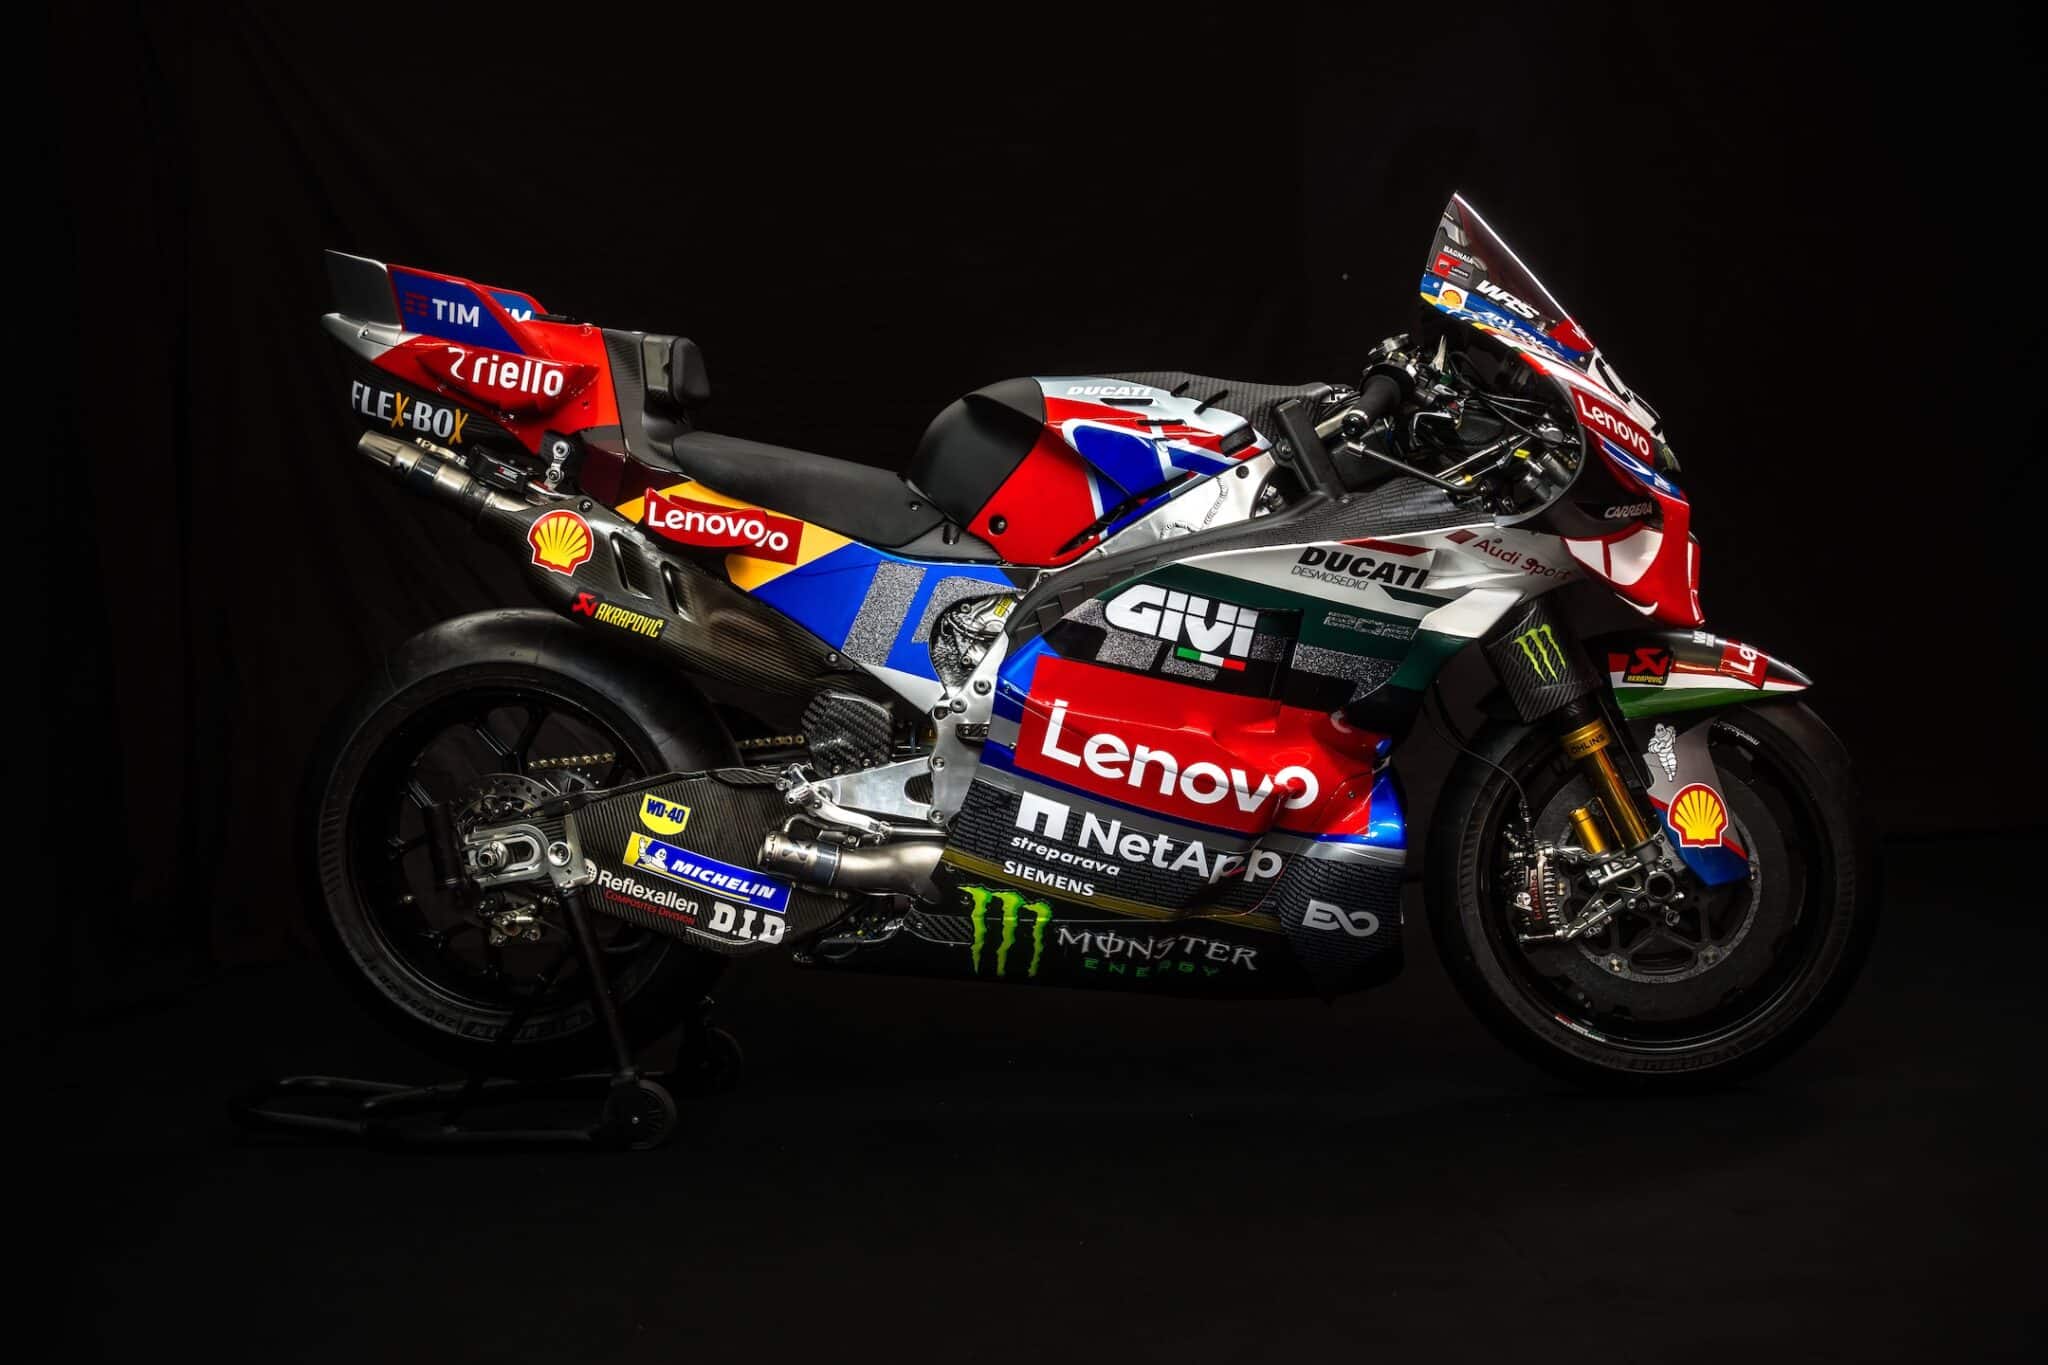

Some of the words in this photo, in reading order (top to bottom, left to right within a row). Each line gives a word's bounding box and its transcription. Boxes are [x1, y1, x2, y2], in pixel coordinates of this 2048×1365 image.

[431, 298, 480, 328] TIM
[472, 353, 564, 396] riello
[1067, 385, 1152, 397] DUCATI
[352, 380, 469, 445] FLEX-BOX
[1578, 394, 1650, 456] Lenovo
[646, 502, 768, 540] Lenovo
[1604, 503, 1653, 519] CARRERA
[1291, 564, 1370, 591] DESMOSEDICI
[1299, 546, 1430, 590] DUCATI
[1472, 538, 1521, 564] Audi
[1520, 556, 1571, 580] Sport
[1105, 584, 1259, 657] GIVI
[1041, 699, 1320, 813] Lenovo
[646, 798, 685, 824] WD-40
[1011, 835, 1121, 877] streparava
[1078, 812, 1283, 884] NetApp
[597, 870, 699, 916] Reflexallen
[671, 860, 776, 900] MICHELIN
[1003, 860, 1095, 897] SIEMENS
[1056, 927, 1259, 970] MONSTER
[1084, 958, 1221, 978] ENERGY
